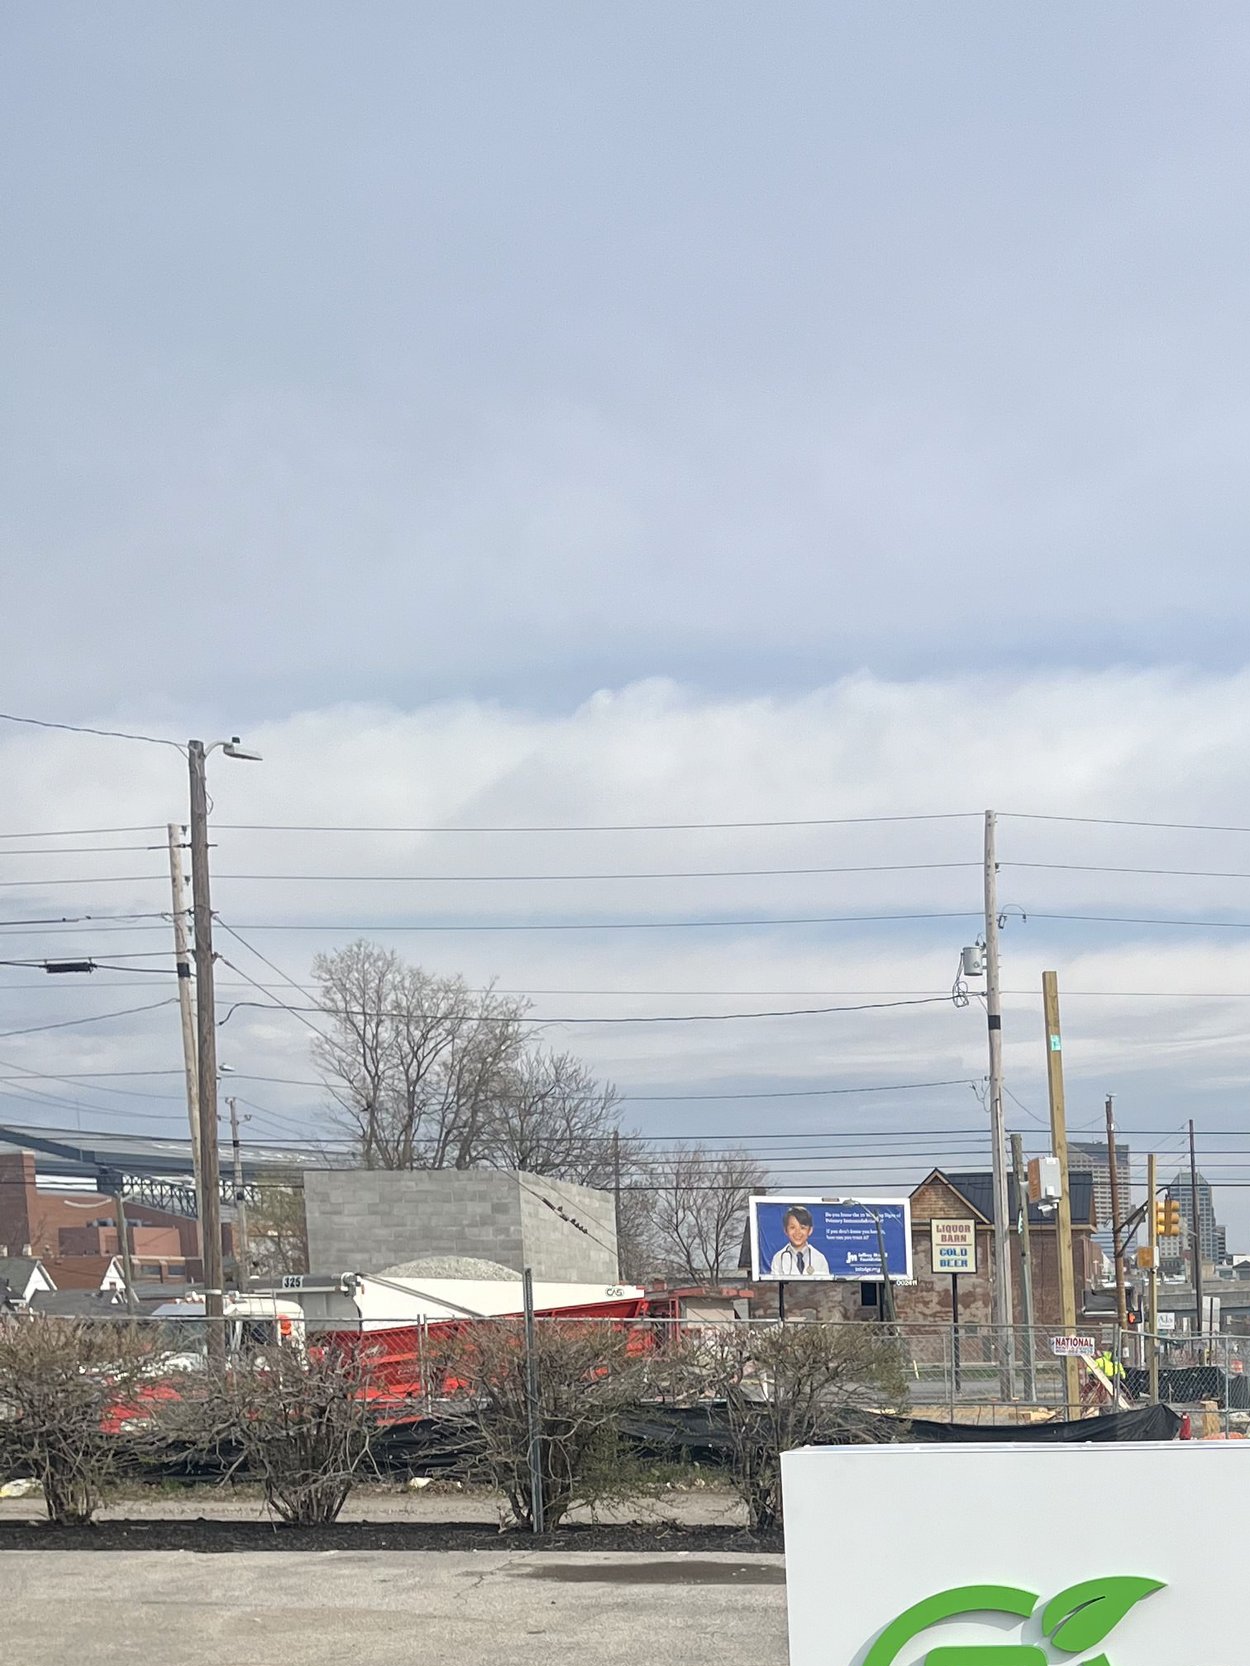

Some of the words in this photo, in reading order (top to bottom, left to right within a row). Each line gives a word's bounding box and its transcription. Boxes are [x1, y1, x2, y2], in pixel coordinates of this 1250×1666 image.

[936, 1224, 970, 1233] LIQUOR
[940, 1248, 967, 1256] COLD
[940, 1259, 968, 1267] BEER
[284, 1277, 301, 1288] 325
[1055, 1337, 1093, 1347] NATIONAL
